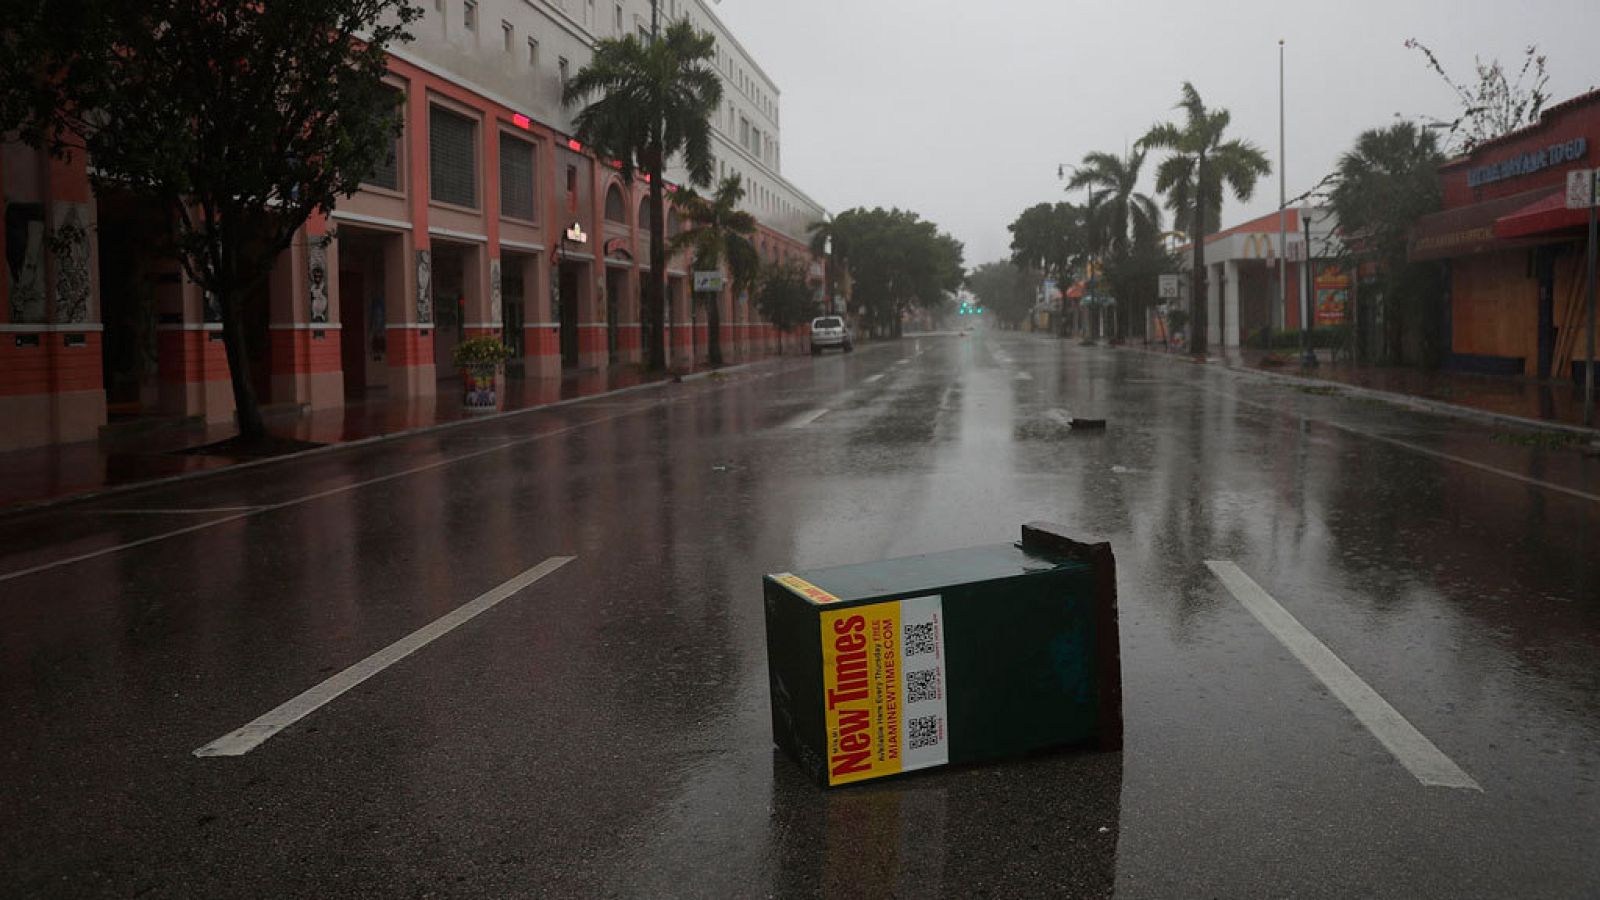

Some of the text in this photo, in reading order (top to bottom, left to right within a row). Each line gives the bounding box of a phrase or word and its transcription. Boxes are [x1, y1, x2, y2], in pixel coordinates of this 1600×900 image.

[873, 642, 883, 680] Thursday
[828, 614, 873, 777] New Times
[875, 682, 884, 704] Every
[883, 618, 898, 759] MIAMINEWTIMES.COM
[875, 705, 884, 724] Here
[876, 726, 885, 762] Available
